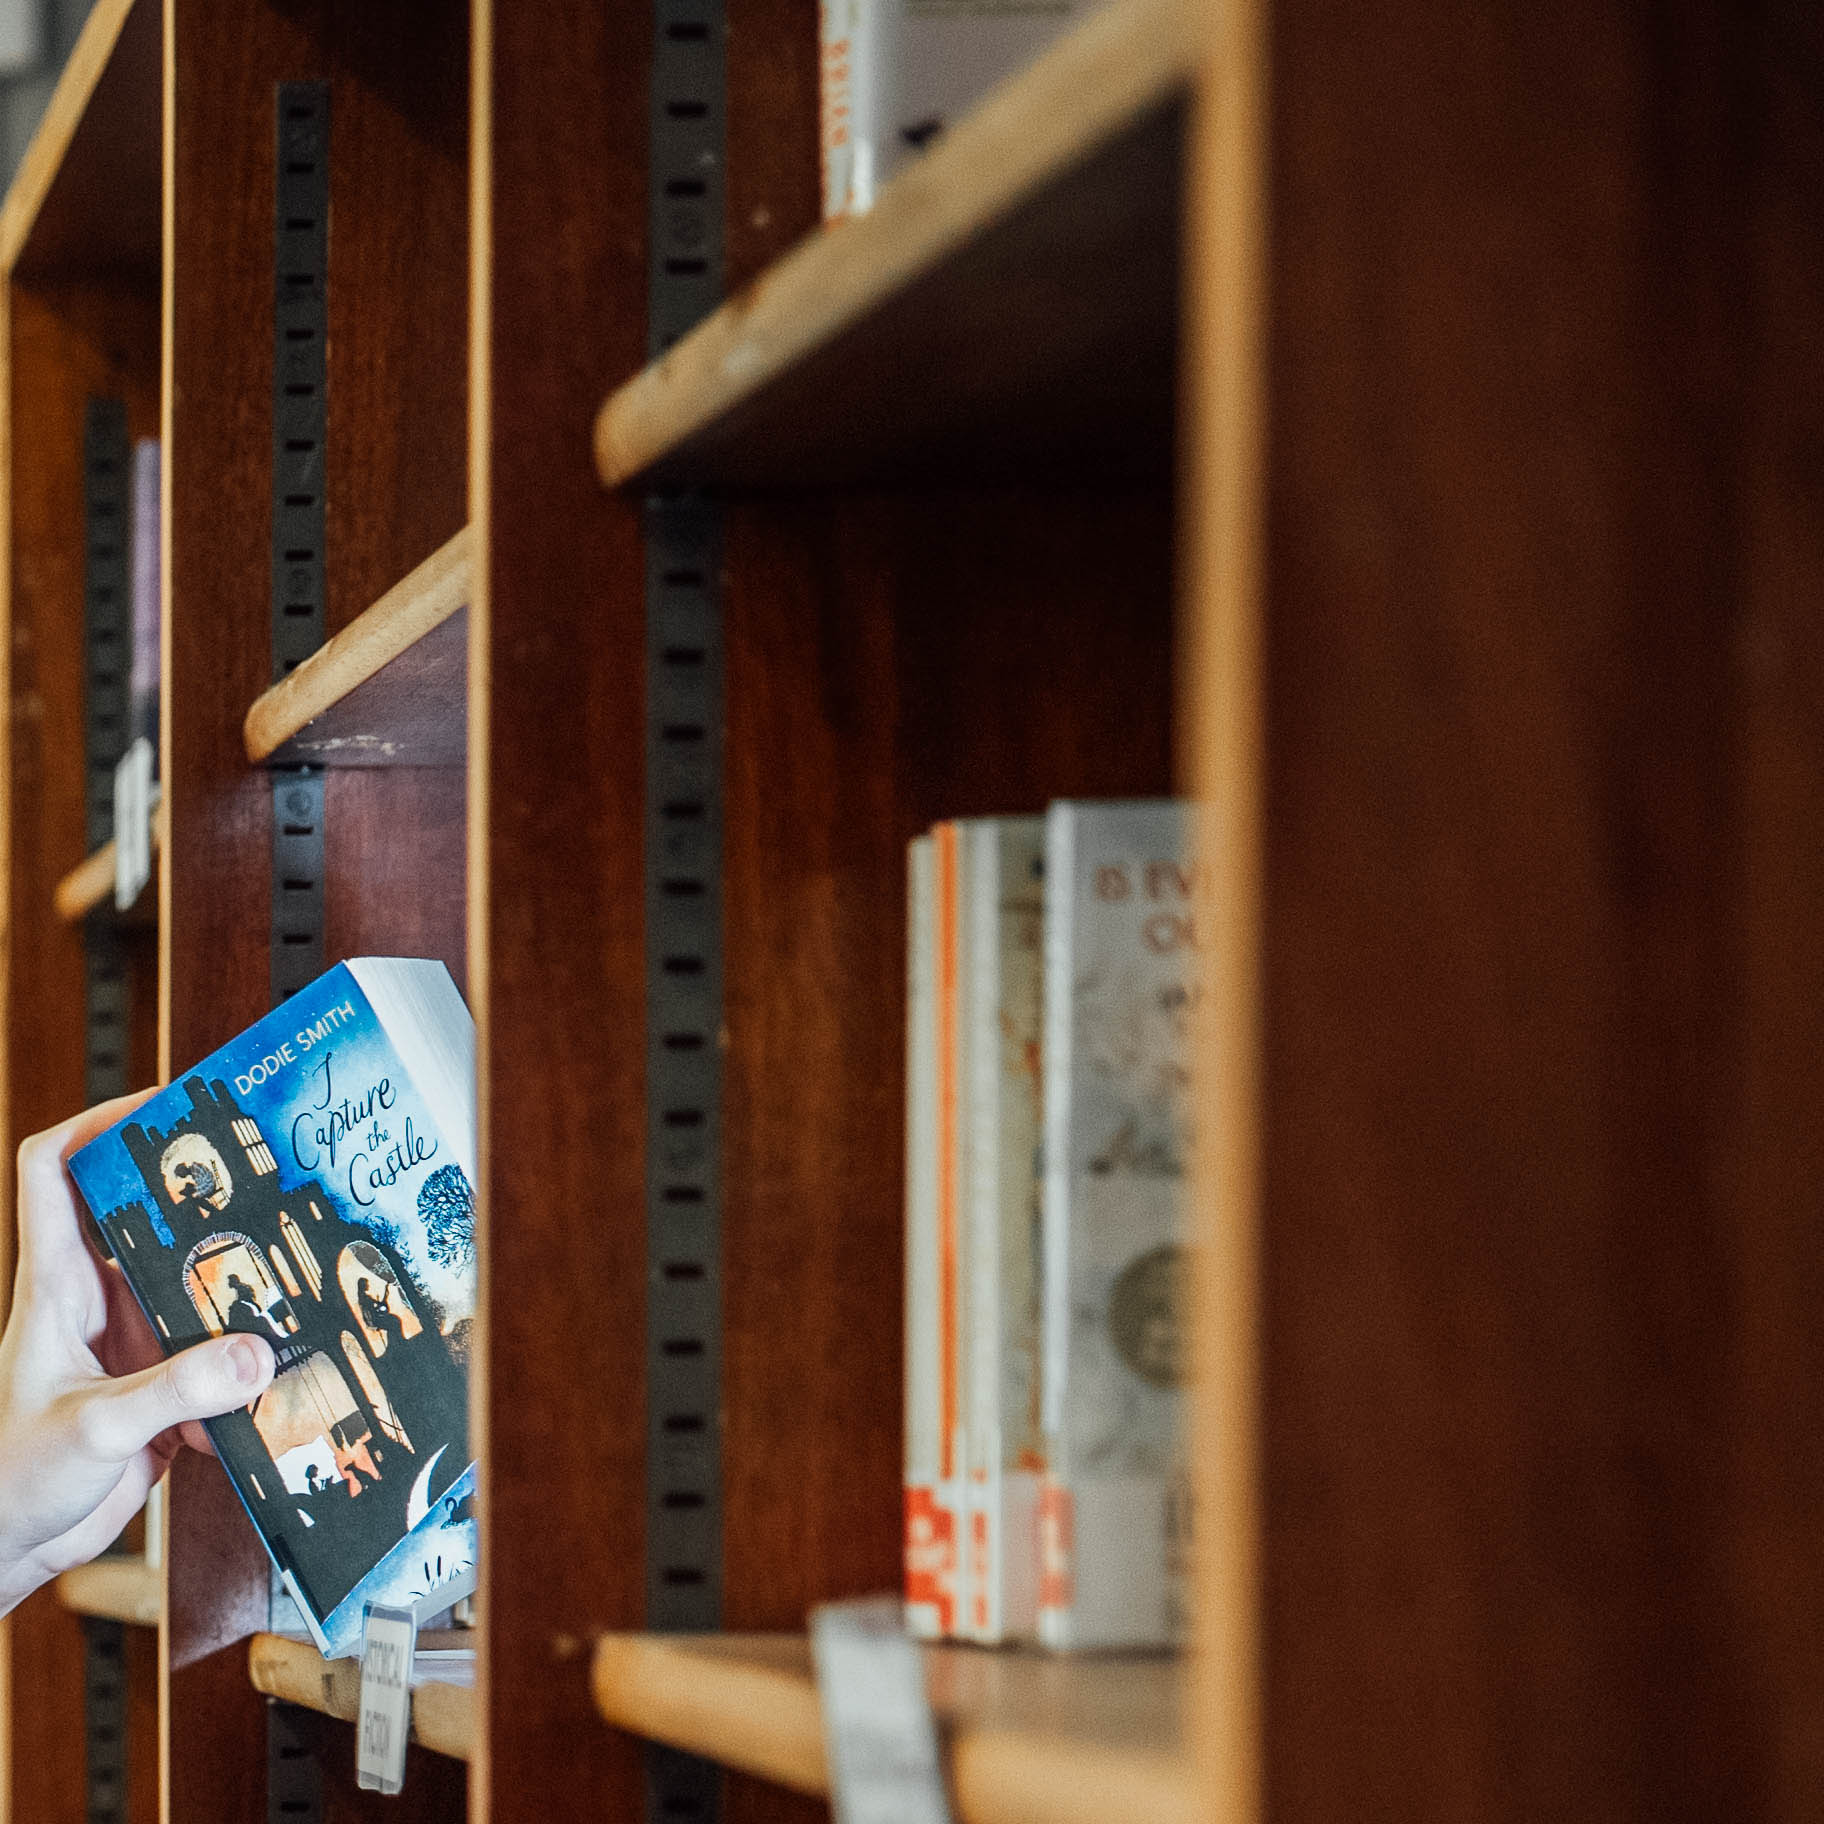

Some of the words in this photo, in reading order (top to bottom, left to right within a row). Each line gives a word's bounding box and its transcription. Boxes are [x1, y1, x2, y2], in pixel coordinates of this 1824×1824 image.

[234, 1042, 297, 1096] DODIE
[296, 1000, 356, 1051] SMITH
[311, 1051, 333, 1111] I
[292, 1077, 397, 1172] Capture
[349, 1116, 438, 1207] Castle
[366, 1120, 392, 1152] the
